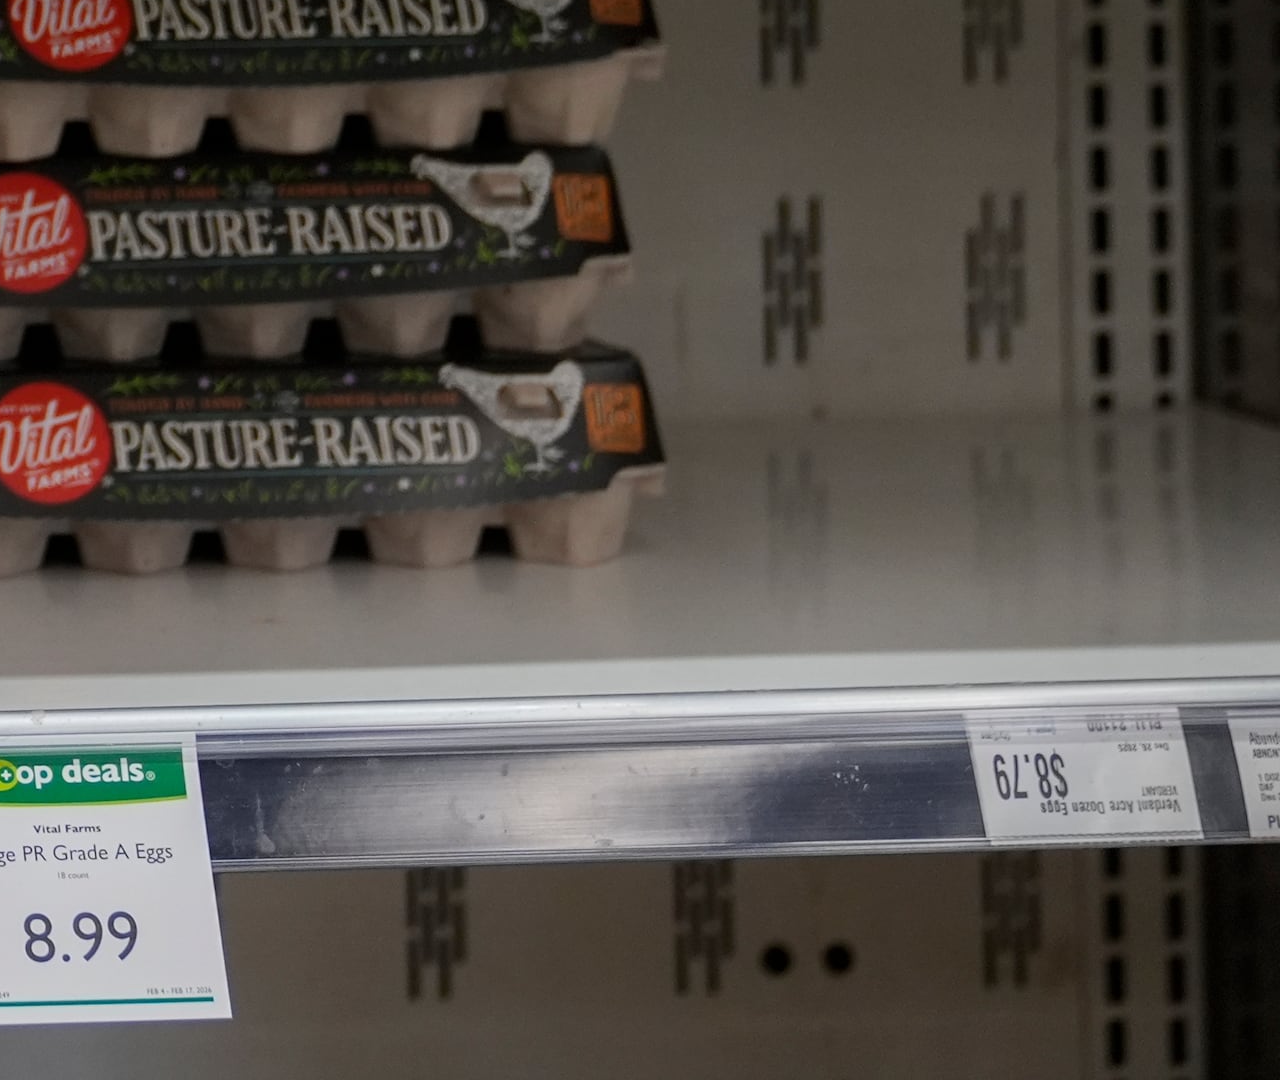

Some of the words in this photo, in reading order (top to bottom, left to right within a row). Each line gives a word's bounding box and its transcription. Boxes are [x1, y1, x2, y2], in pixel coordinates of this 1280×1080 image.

[86, 205, 452, 262] PASTURE-RAISED
[110, 414, 481, 471] PASTURE-RAISED
[993, 748, 1068, 800] $8.79
[1142, 785, 1178, 796] VERDANT
[1040, 799, 1069, 816] Eggs
[1072, 800, 1105, 815] Dozen
[1108, 799, 1135, 813] Acre
[1137, 797, 1181, 813] Verdant
[34, 824, 61, 834] Vital
[65, 824, 102, 834] Farms
[23, 845, 46, 862] PR
[53, 844, 108, 862] Grade
[115, 843, 130, 860] A
[136, 843, 174, 865] Eggs
[57, 872, 66, 880] 18
[68, 872, 90, 880] count
[23, 911, 138, 963] 8.99
